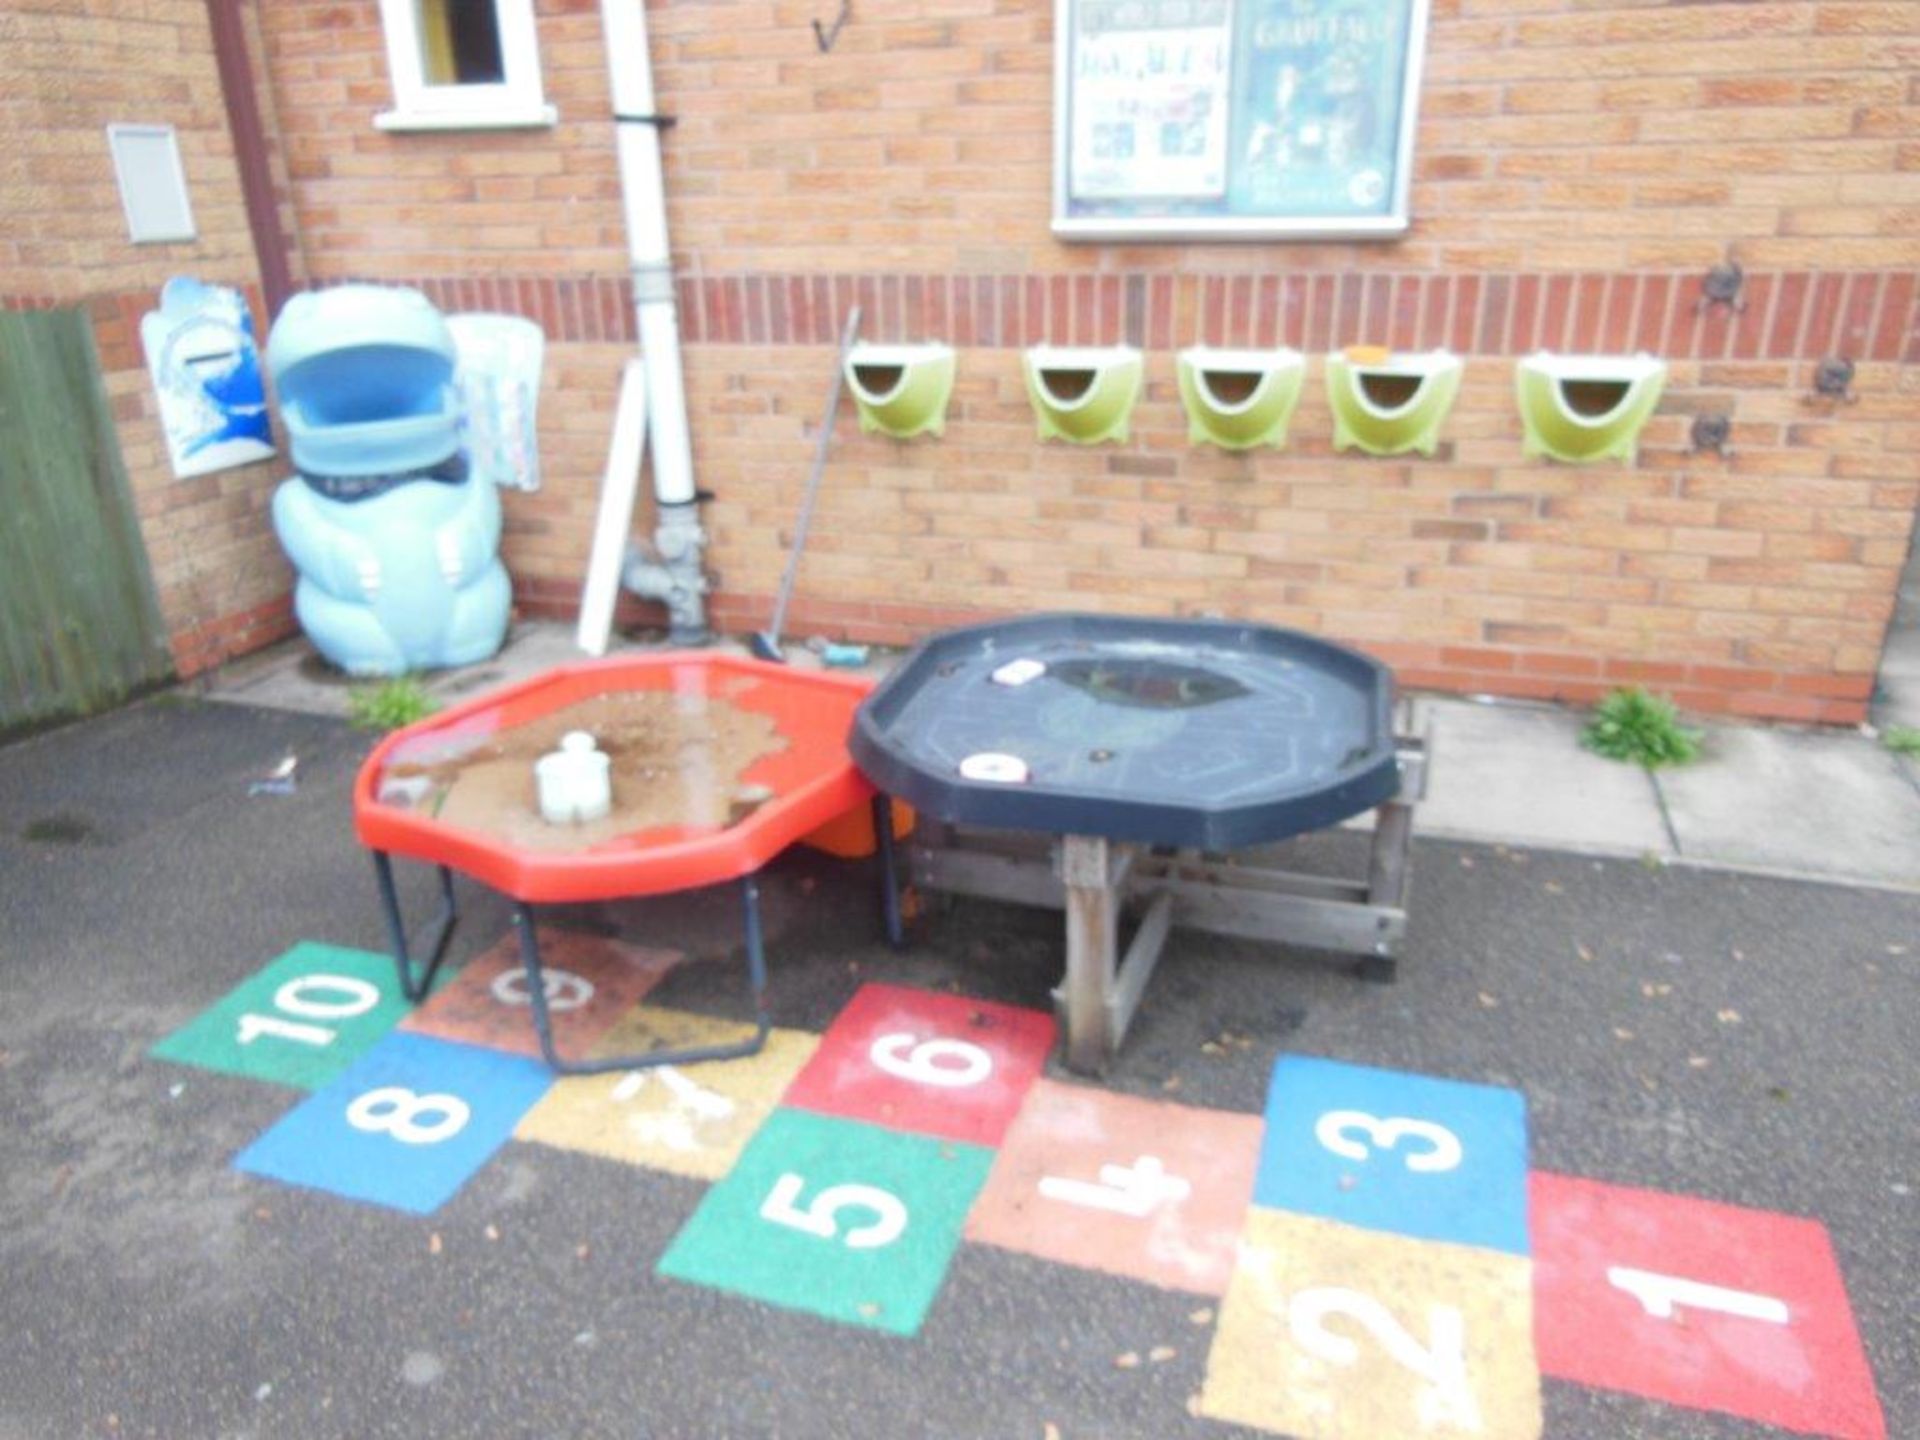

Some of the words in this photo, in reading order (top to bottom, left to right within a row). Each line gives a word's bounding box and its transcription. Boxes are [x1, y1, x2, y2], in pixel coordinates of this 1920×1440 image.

[236, 973, 381, 1046] 10
[491, 968, 594, 1011] 9
[868, 1031, 993, 1090] 6
[345, 1086, 471, 1146] 8
[1314, 1109, 1464, 1174] 3
[760, 1173, 909, 1250] 5
[1038, 1156, 1192, 1217] 4
[1605, 1265, 1790, 1324] 1
[1289, 1286, 1480, 1430] 2
